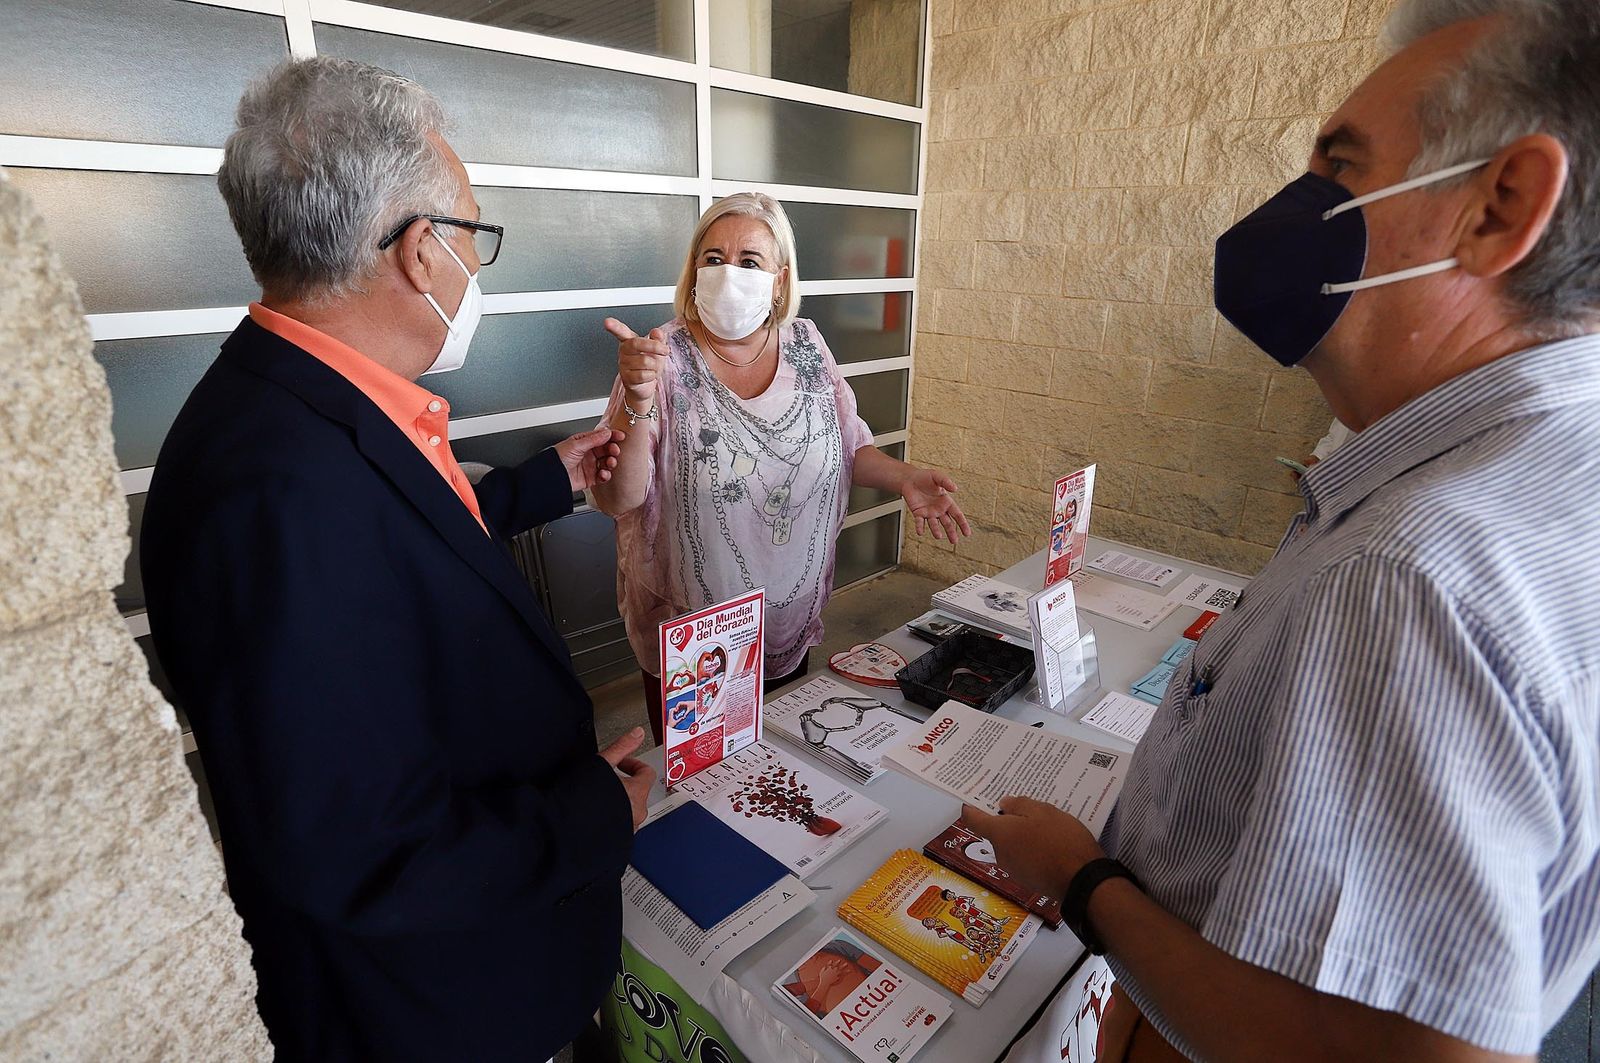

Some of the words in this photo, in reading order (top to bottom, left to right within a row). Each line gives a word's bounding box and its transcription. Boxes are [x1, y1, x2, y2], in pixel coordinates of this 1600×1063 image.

[1052, 592, 1067, 605] ANCCO
[696, 628, 712, 641] del
[714, 615, 754, 635] Corazón
[697, 618, 714, 631] Día
[716, 603, 753, 625] Mundial
[762, 678, 830, 715] CIENCIA
[925, 718, 954, 744] ANCCO
[681, 743, 770, 793] CIENCIA
[817, 790, 847, 810] Regenerar
[836, 969, 903, 1041] ¡Actúa!
[905, 1006, 927, 1028] MAPFRE
